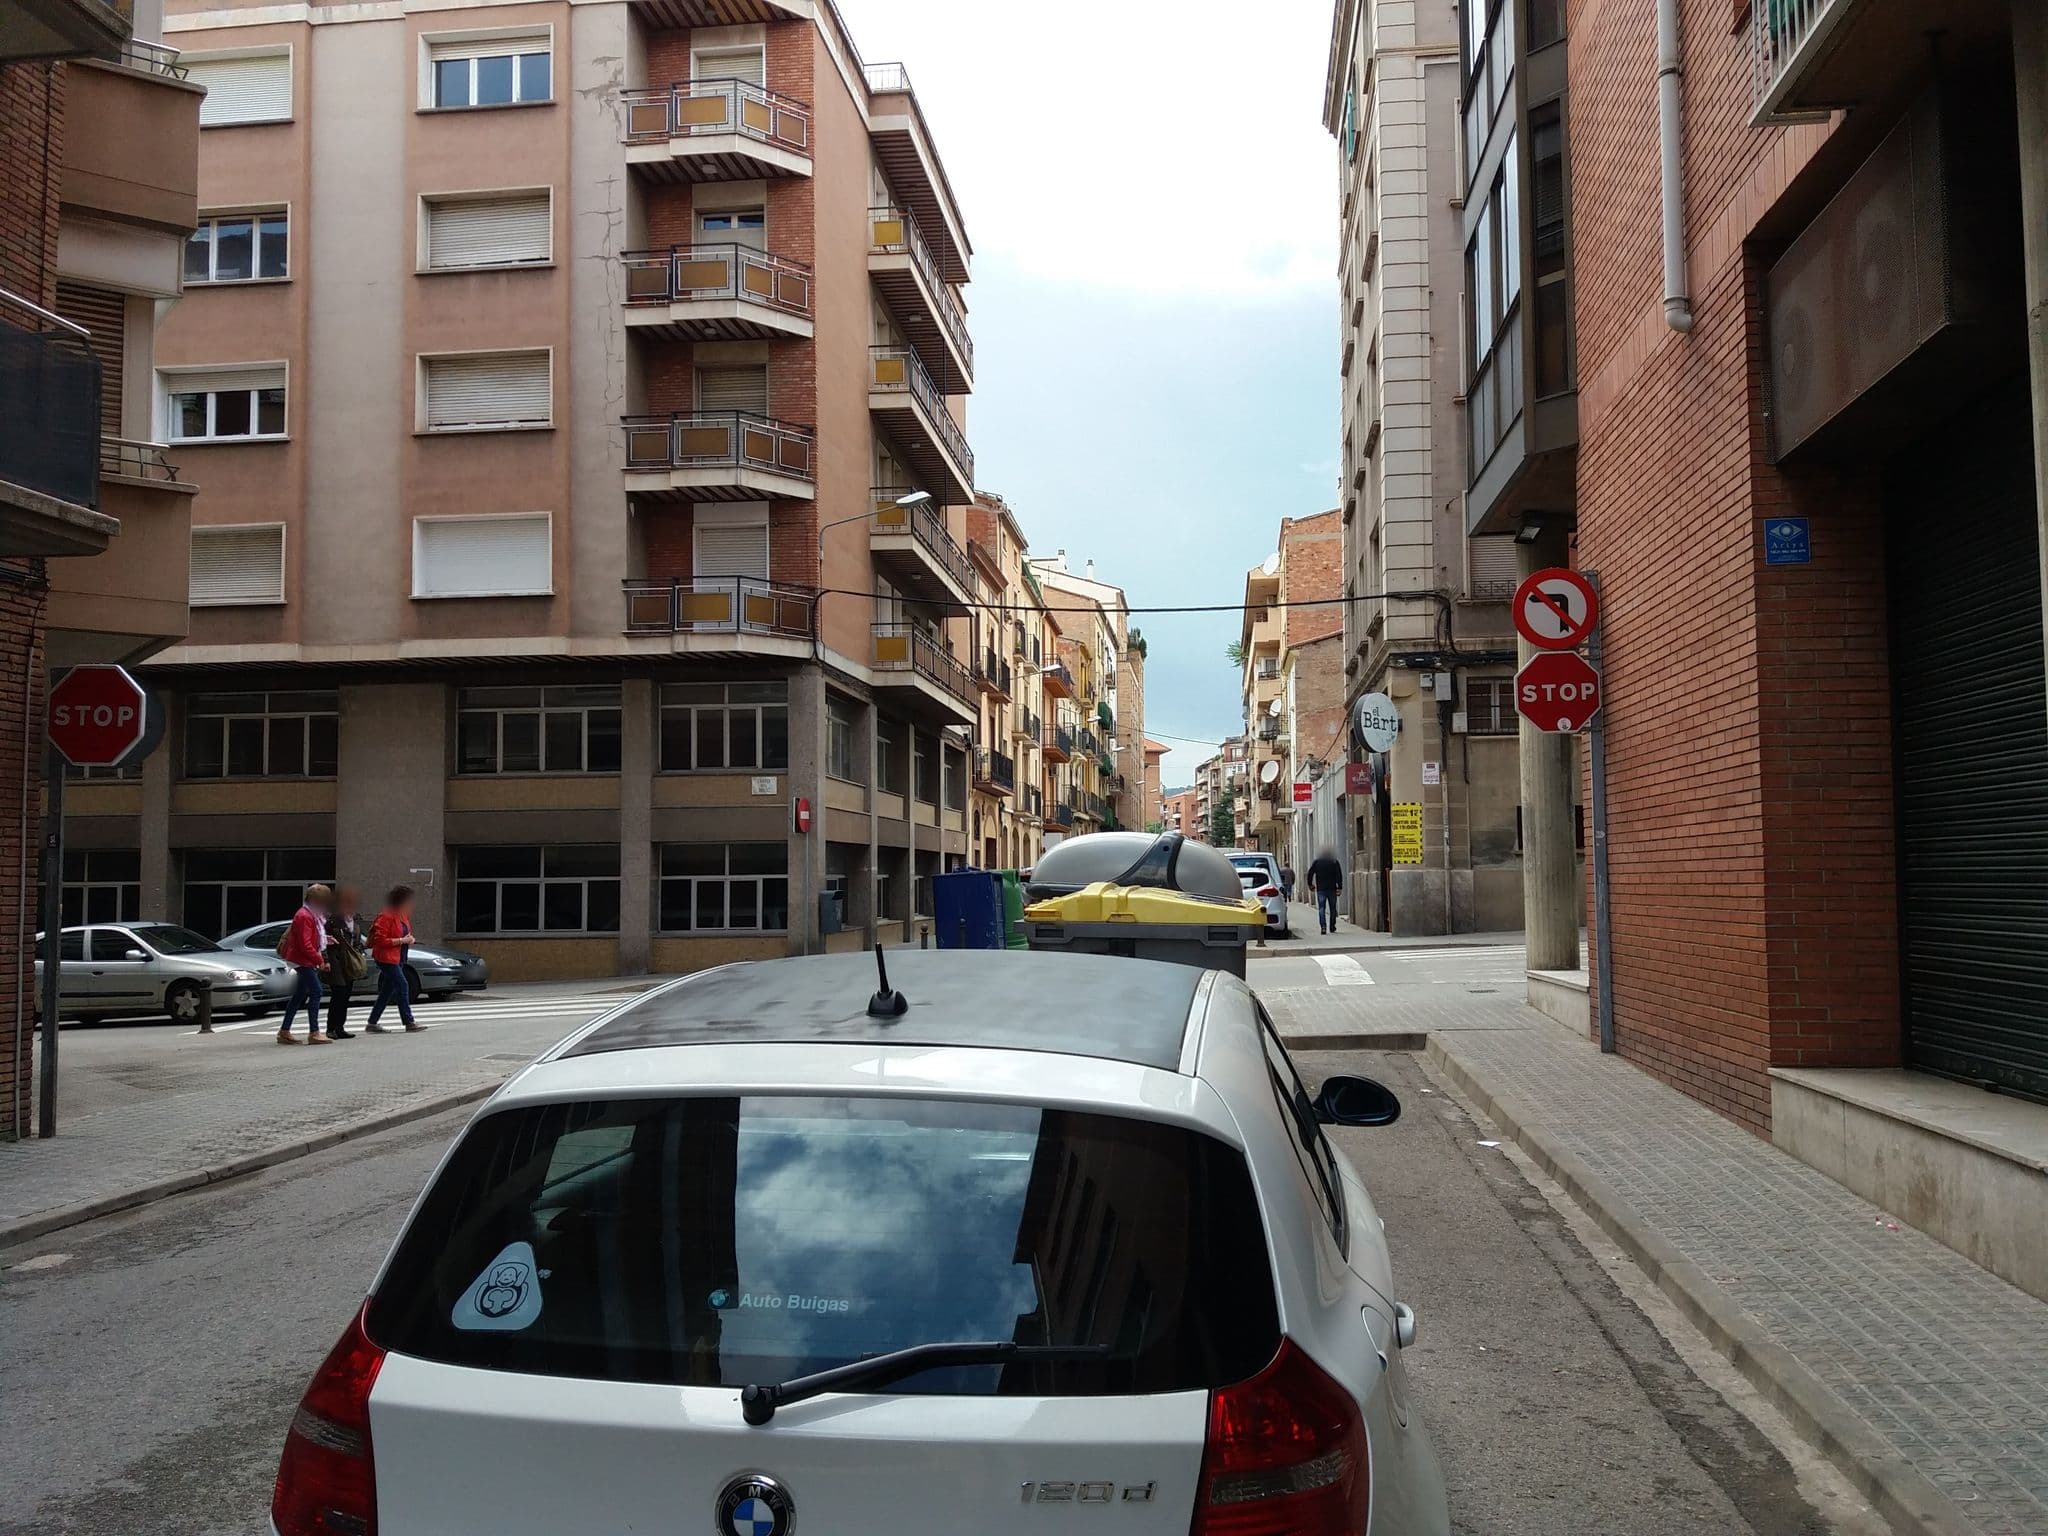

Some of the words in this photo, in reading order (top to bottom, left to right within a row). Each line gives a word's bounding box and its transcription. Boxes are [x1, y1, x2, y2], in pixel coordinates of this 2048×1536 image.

[1522, 682, 1596, 703] STOP
[54, 704, 134, 727] STOP
[1363, 711, 1397, 732] Bart
[1372, 706, 1379, 717] el
[739, 1293, 781, 1309] Auto
[787, 1295, 849, 1313] Buigas
[727, 1484, 784, 1510] BMW
